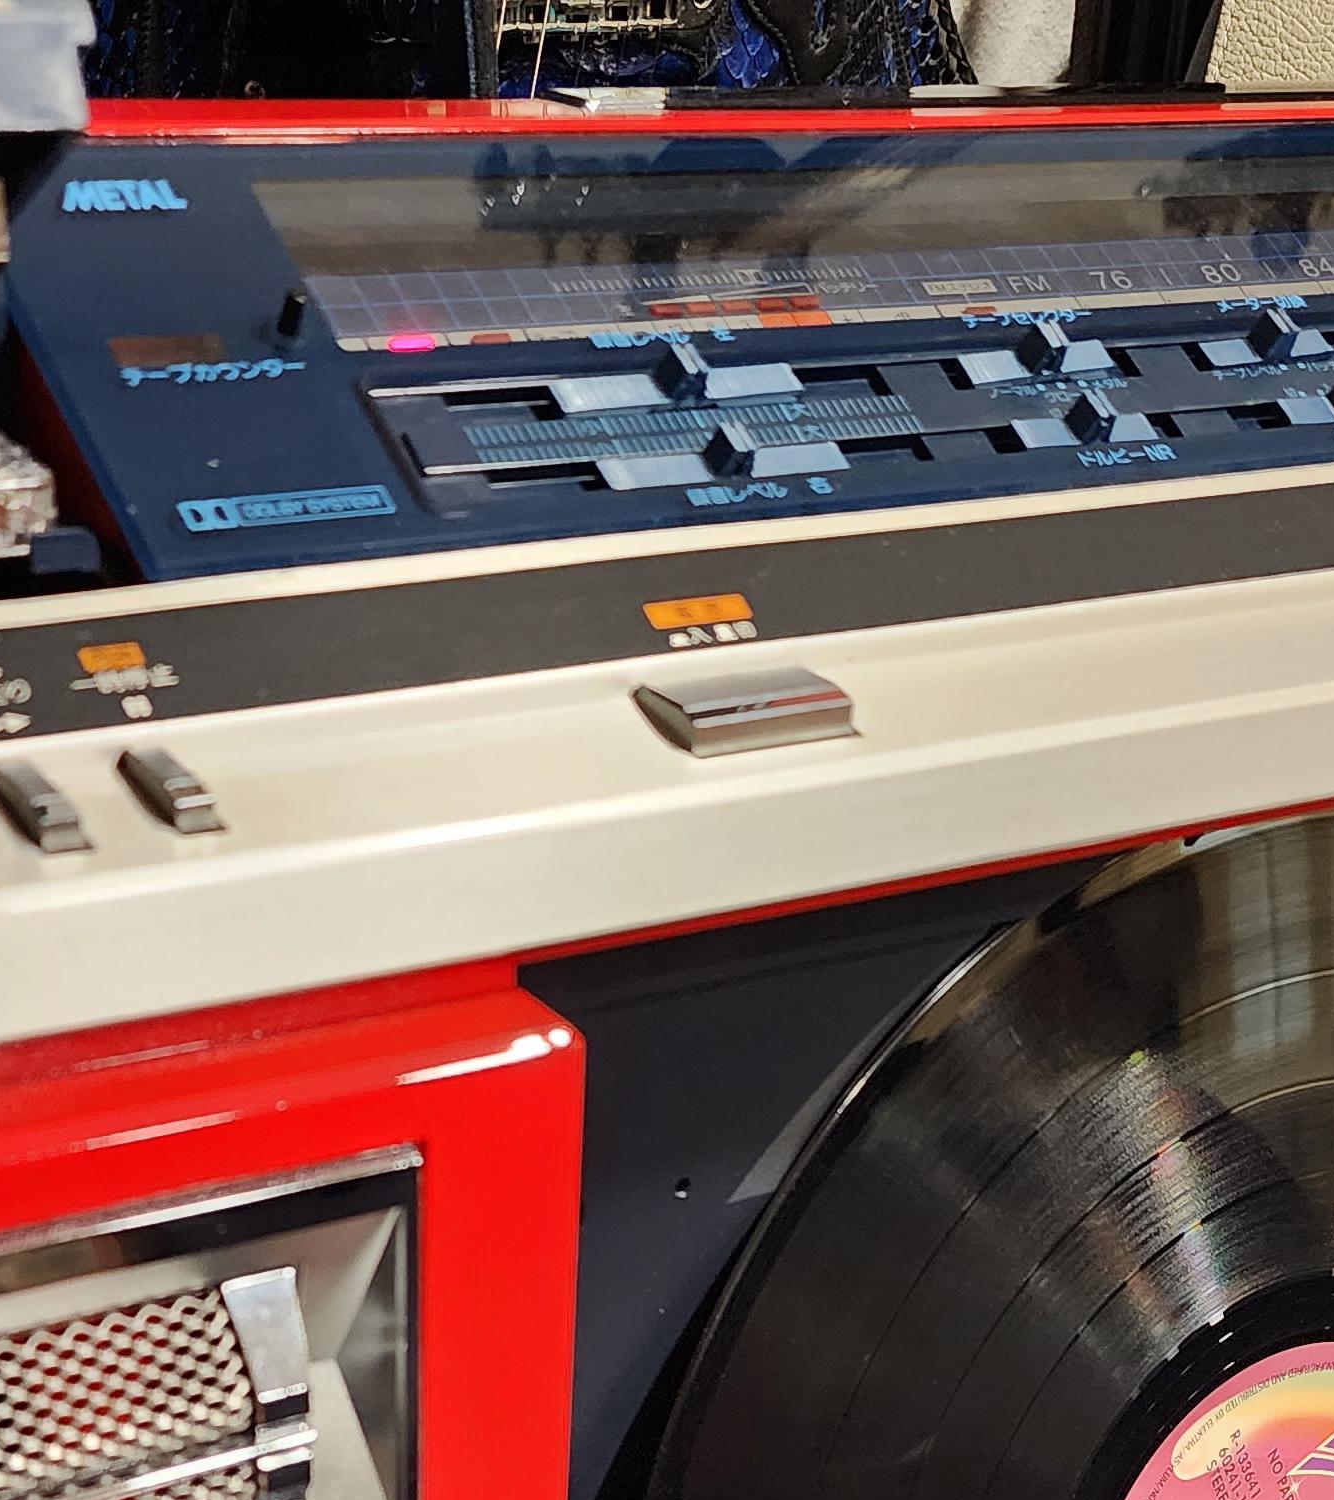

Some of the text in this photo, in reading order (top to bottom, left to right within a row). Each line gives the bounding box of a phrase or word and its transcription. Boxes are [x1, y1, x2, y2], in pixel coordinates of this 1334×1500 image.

[62, 179, 187, 212] METAL
[1005, 275, 1052, 294] FM
[1088, 270, 1134, 291] 76
[1200, 262, 1242, 284] 80
[120, 358, 307, 388] テープカウンター
[1229, 1428, 1262, 1500] R-133641
[1267, 1447, 1284, 1477] NO
